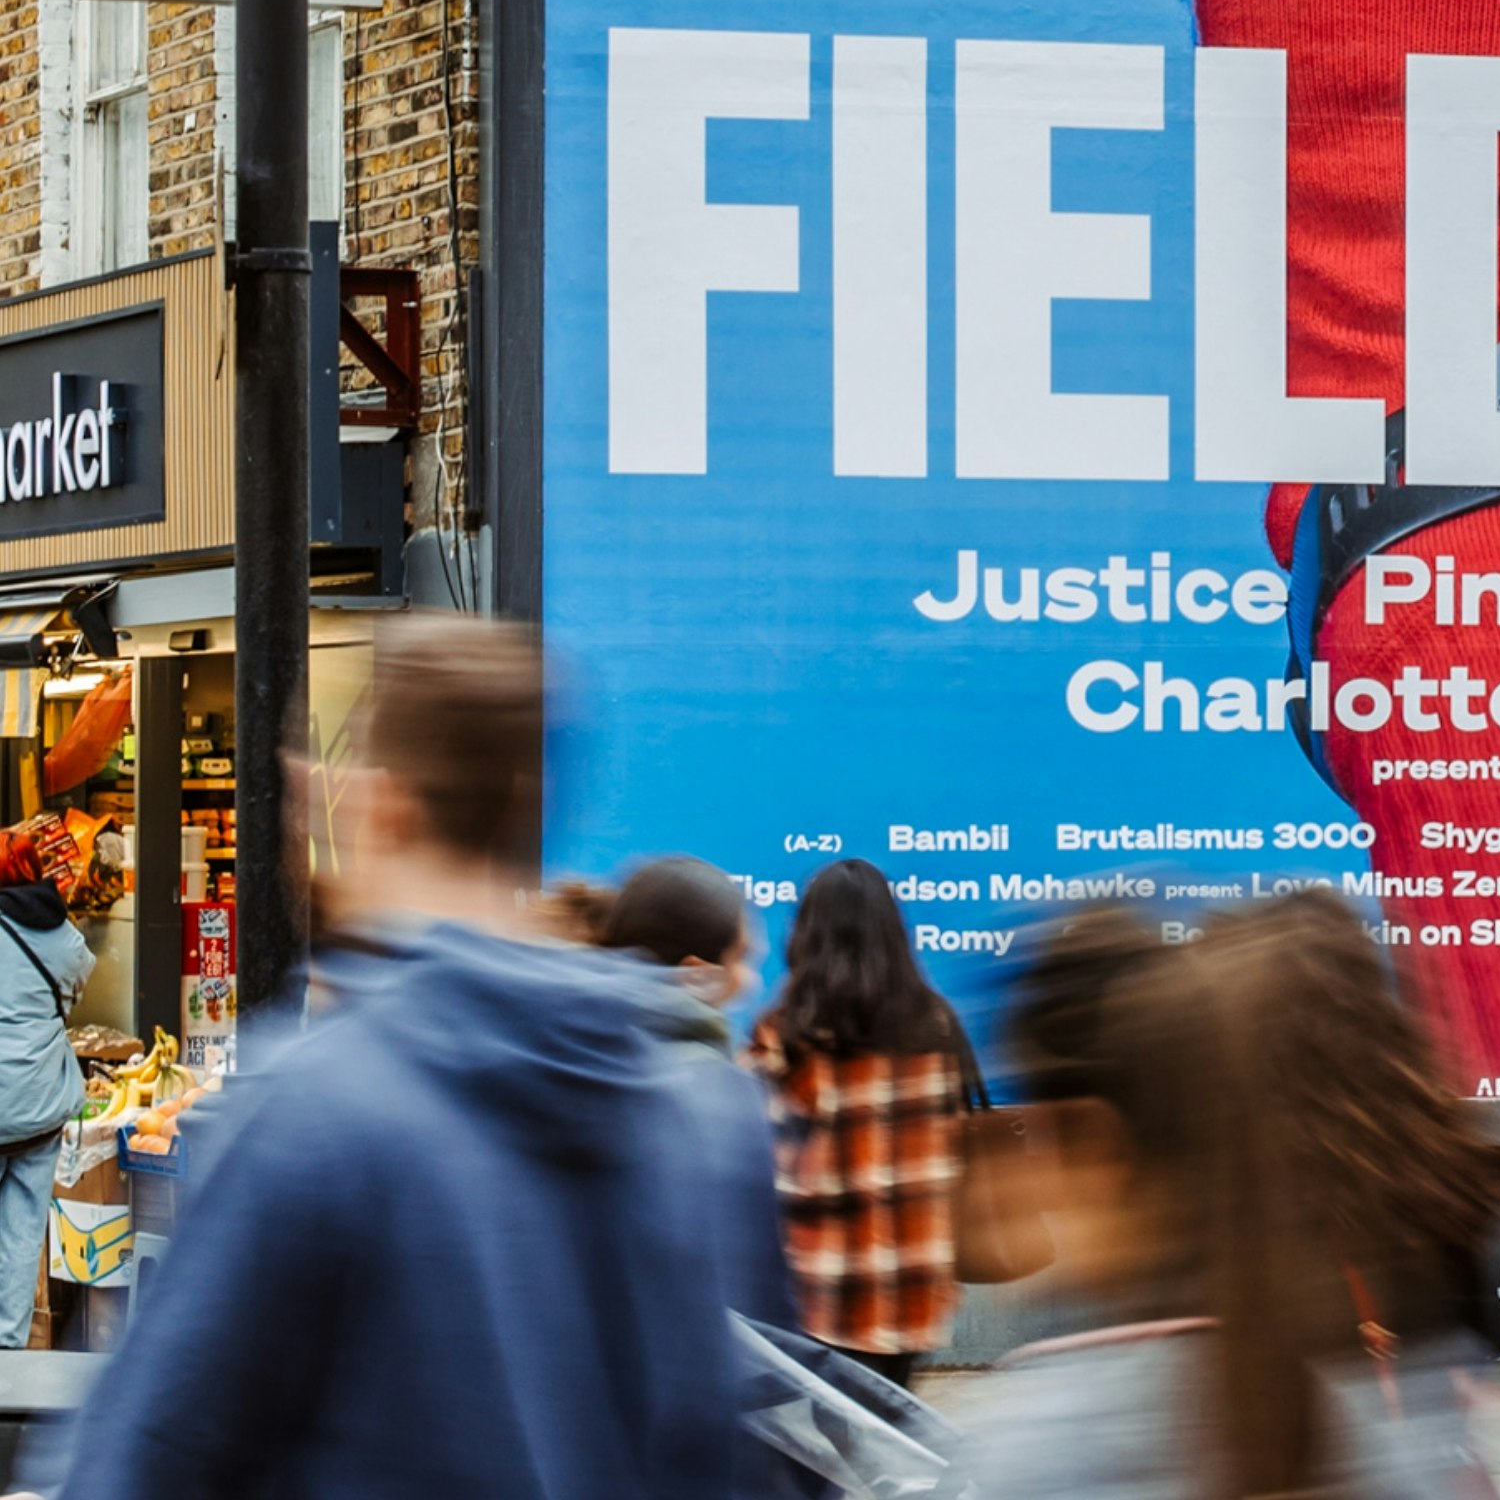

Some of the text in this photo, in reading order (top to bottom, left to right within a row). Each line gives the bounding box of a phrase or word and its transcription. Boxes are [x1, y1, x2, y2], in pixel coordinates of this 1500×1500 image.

[0, 370, 114, 503] arket
[912, 549, 1290, 623] Justice
[783, 833, 843, 853] (A-Z)
[888, 824, 1010, 852] Bambii
[1056, 822, 1265, 851] Brutalismus
[1272, 821, 1377, 850] 3000
[989, 871, 1156, 901] Mohawke
[1164, 880, 1243, 901] present
[1342, 870, 1444, 899] Minus
[914, 924, 1015, 957] Romy
[1419, 924, 1461, 946] on
